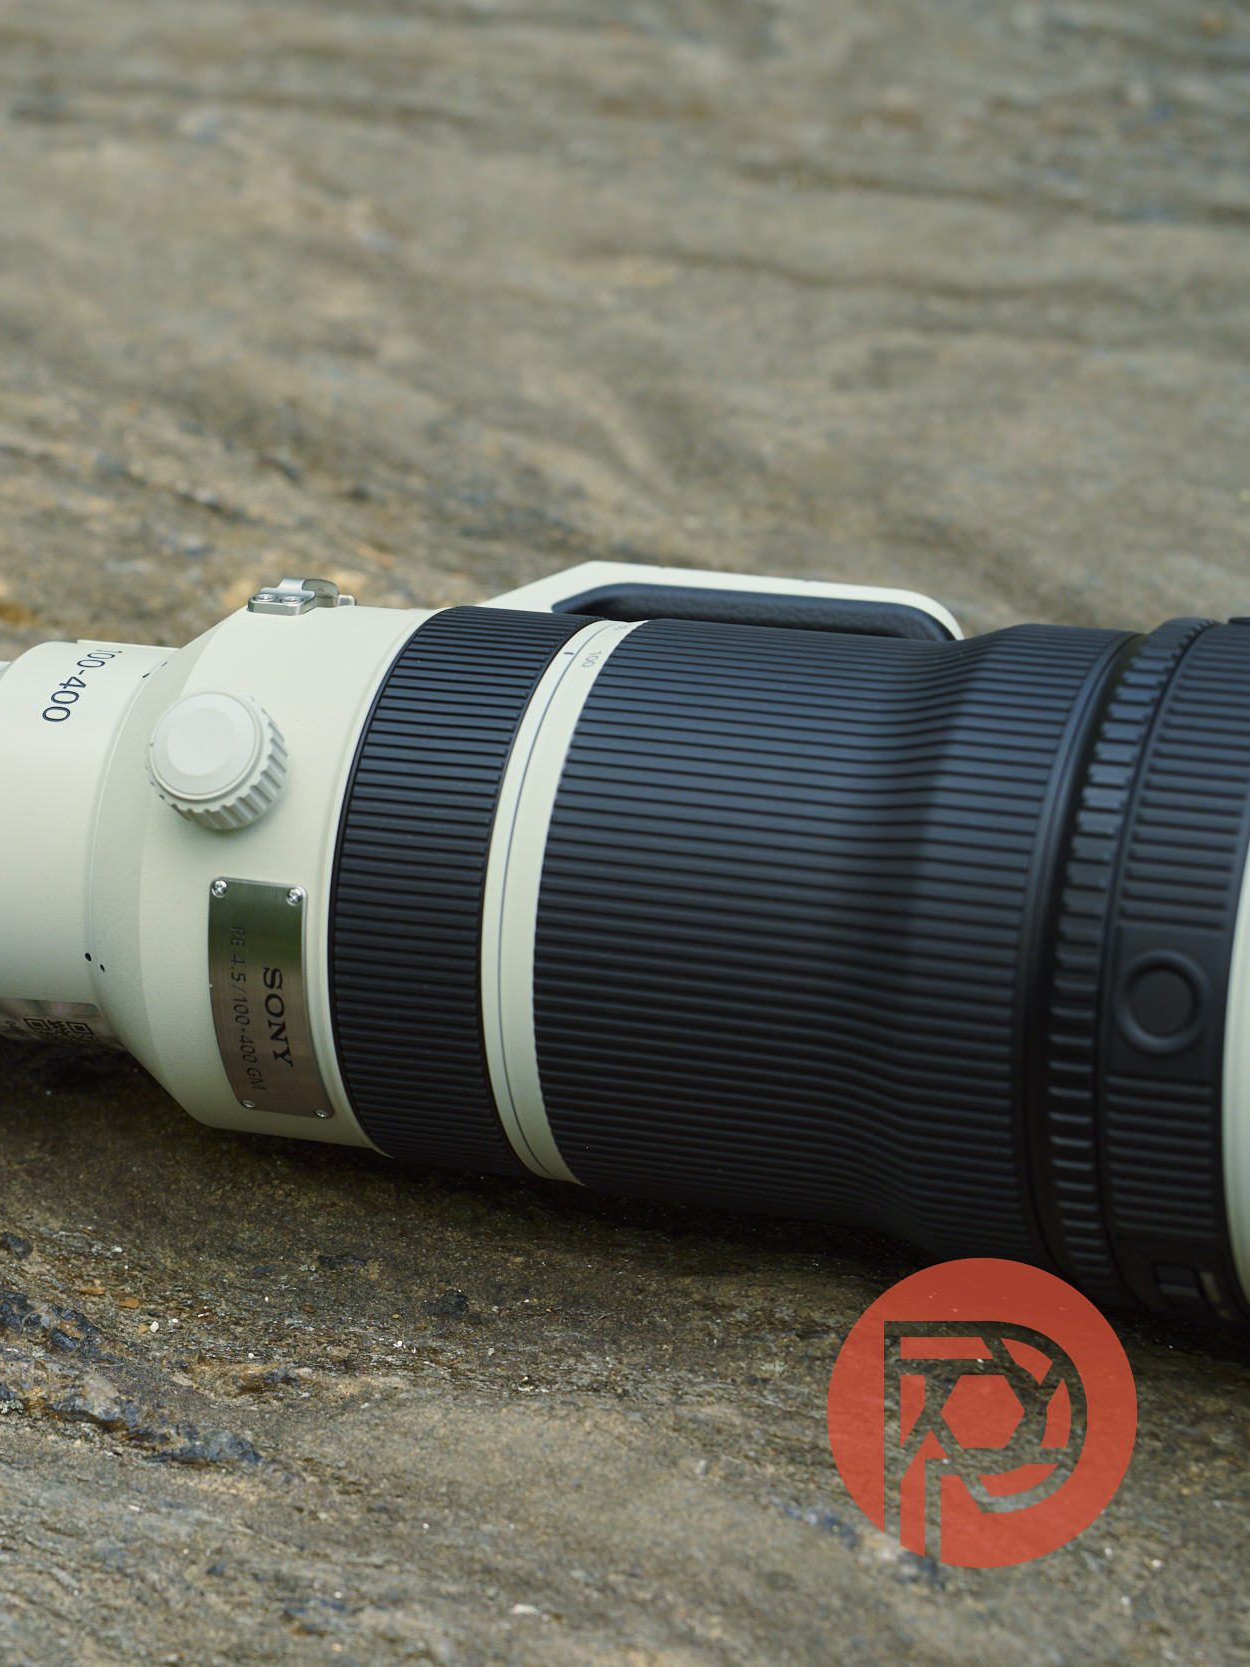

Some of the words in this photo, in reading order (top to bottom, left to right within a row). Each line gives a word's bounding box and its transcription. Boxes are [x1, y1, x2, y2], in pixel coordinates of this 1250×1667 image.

[41, 649, 123, 723] 100-400
[229, 926, 246, 946] FE
[262, 967, 294, 1068] SONY
